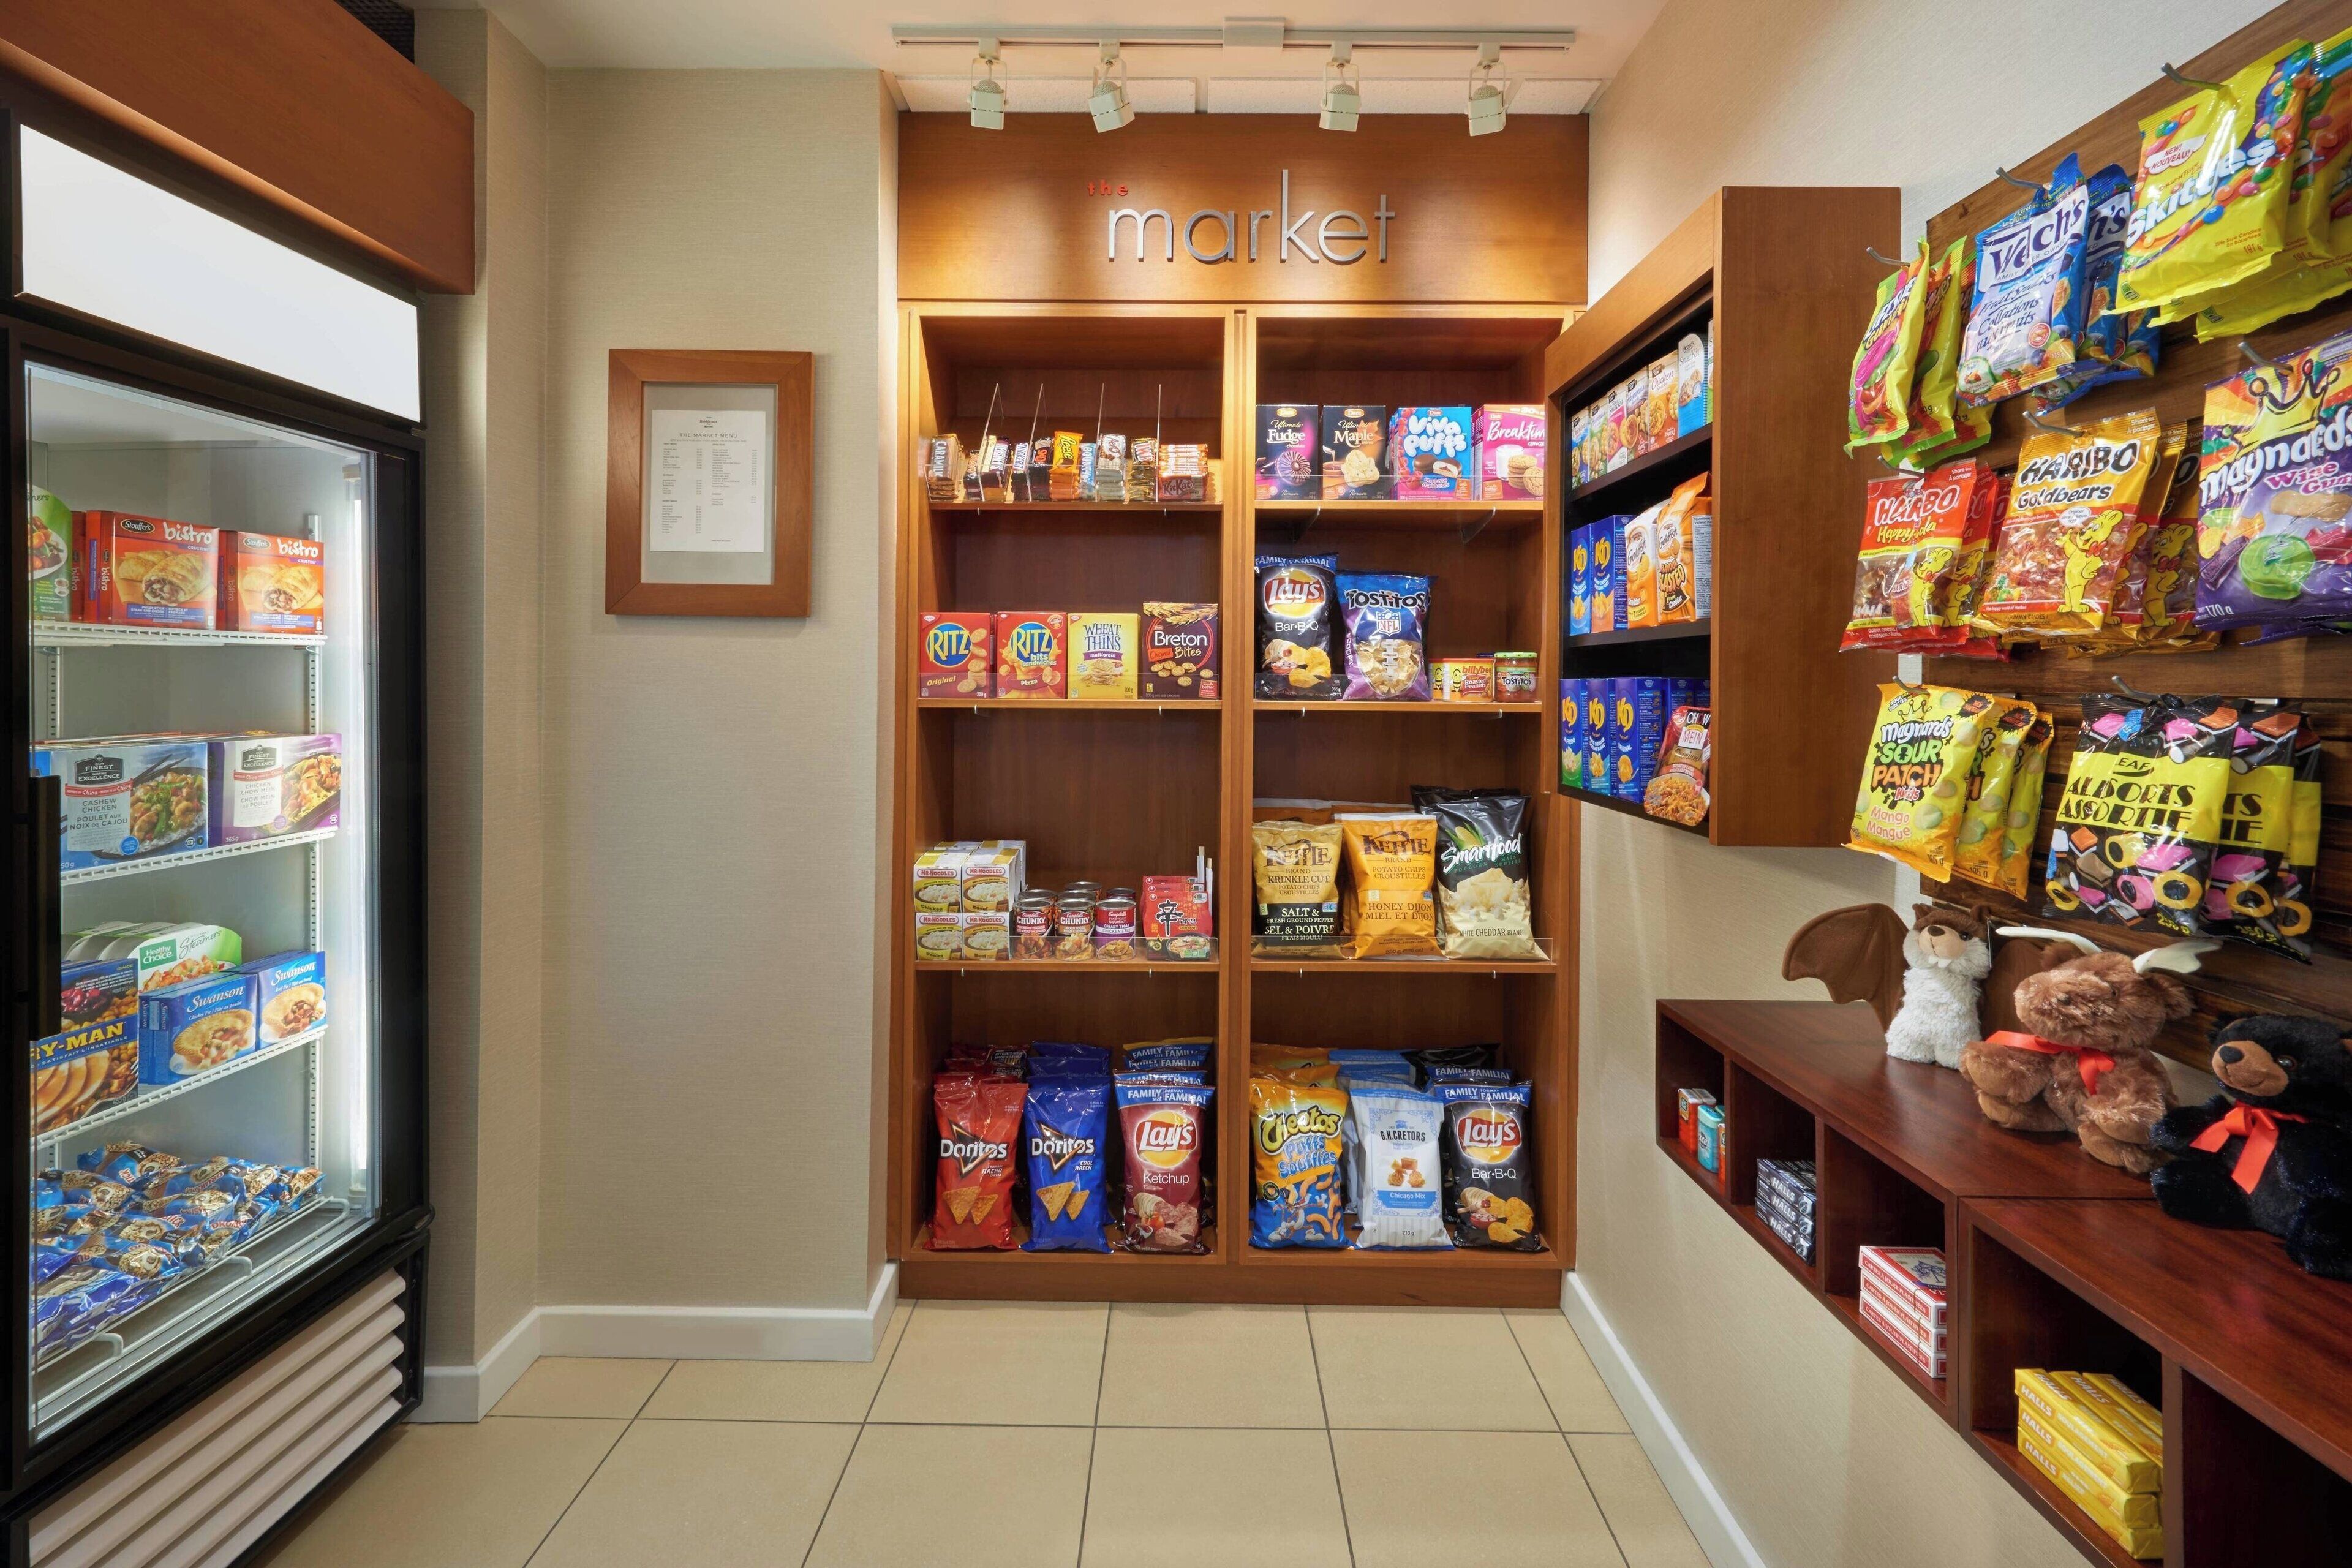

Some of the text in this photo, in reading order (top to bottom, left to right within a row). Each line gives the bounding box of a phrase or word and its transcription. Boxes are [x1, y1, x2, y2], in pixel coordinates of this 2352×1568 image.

[2151, 149, 2191, 170] NOUVEAU!
[2163, 143, 2184, 158] NEW!
[1087, 179, 1128, 197] the
[1109, 169, 1396, 266] market
[2243, 244, 2257, 255] 191
[1267, 429, 1306, 443] Fudge
[1333, 431, 1374, 447] Maple
[932, 442, 946, 477] CARAMILK
[1012, 443, 1028, 469] SNICKERS
[2018, 439, 2140, 488] HARIBO
[2265, 462, 2339, 490] Wine
[1164, 480, 1194, 495] KitKat
[2016, 483, 2112, 510] Goldbears
[125, 521, 151, 531] Stouffer's
[163, 522, 213, 545] bistro
[277, 538, 319, 558] bistro
[1659, 526, 1678, 549] Goldfish
[1269, 579, 1322, 605] Lay's
[1345, 590, 1426, 612] TOSTITOS
[1083, 624, 1121, 636] WHEAT
[1378, 620, 1398, 631] NFL
[929, 629, 970, 662] RITZ
[1011, 629, 1050, 658] RITZ
[1155, 631, 1208, 646] Breton
[1175, 647, 1202, 658] Bites
[927, 676, 956, 686] Original
[1502, 677, 1531, 686] TOSTITOS
[1682, 730, 1702, 744] MEIN
[1881, 715, 1954, 744] maynards
[1880, 739, 1943, 764] SOUR
[1871, 764, 1943, 788] PATCH
[1895, 787, 1920, 801] Kids
[77, 813, 108, 823] POULET
[82, 804, 117, 813] CHICKEN
[1871, 805, 1910, 826] Mango
[1866, 821, 1912, 842] Mangue
[1360, 831, 1432, 855] KETTLE
[1441, 832, 1522, 873] Smartfood
[1281, 908, 1310, 916] SALT
[1408, 903, 1431, 912] DIJON
[1265, 926, 1283, 935] SEL
[1296, 925, 1335, 934] POIVRE
[146, 946, 171, 957] Healthy
[179, 930, 221, 959] Steamers
[143, 951, 172, 964] Choice
[271, 962, 315, 986] Swanson
[187, 986, 244, 1012] Swanson
[1133, 1047, 1163, 1060] FAMILY
[1471, 1069, 1511, 1080] FAMILIAL
[1128, 1088, 1161, 1099] FAMILY
[1446, 1088, 1477, 1098] FAMILY
[1139, 1121, 1194, 1152] Lay's
[1261, 1104, 1341, 1154] Cheetos
[1463, 1118, 1515, 1147] Lay's
[941, 1139, 1008, 1158] Doritos
[1031, 1138, 1095, 1156] Doritos
[1284, 1135, 1325, 1159] Puffs
[1144, 1172, 1189, 1185] Ketchup
[1772, 1177, 1795, 1200] HALLS
[1773, 1196, 1796, 1220] HALLS
[1770, 1218, 1792, 1242] HALLS
[2034, 1373, 2071, 1400] HALLS
[2071, 1376, 2109, 1403] HALLS
[2021, 1384, 2052, 1417] HALLS
[2022, 1412, 2052, 1444] HALLS
[2025, 1441, 2057, 1475] HALLS
